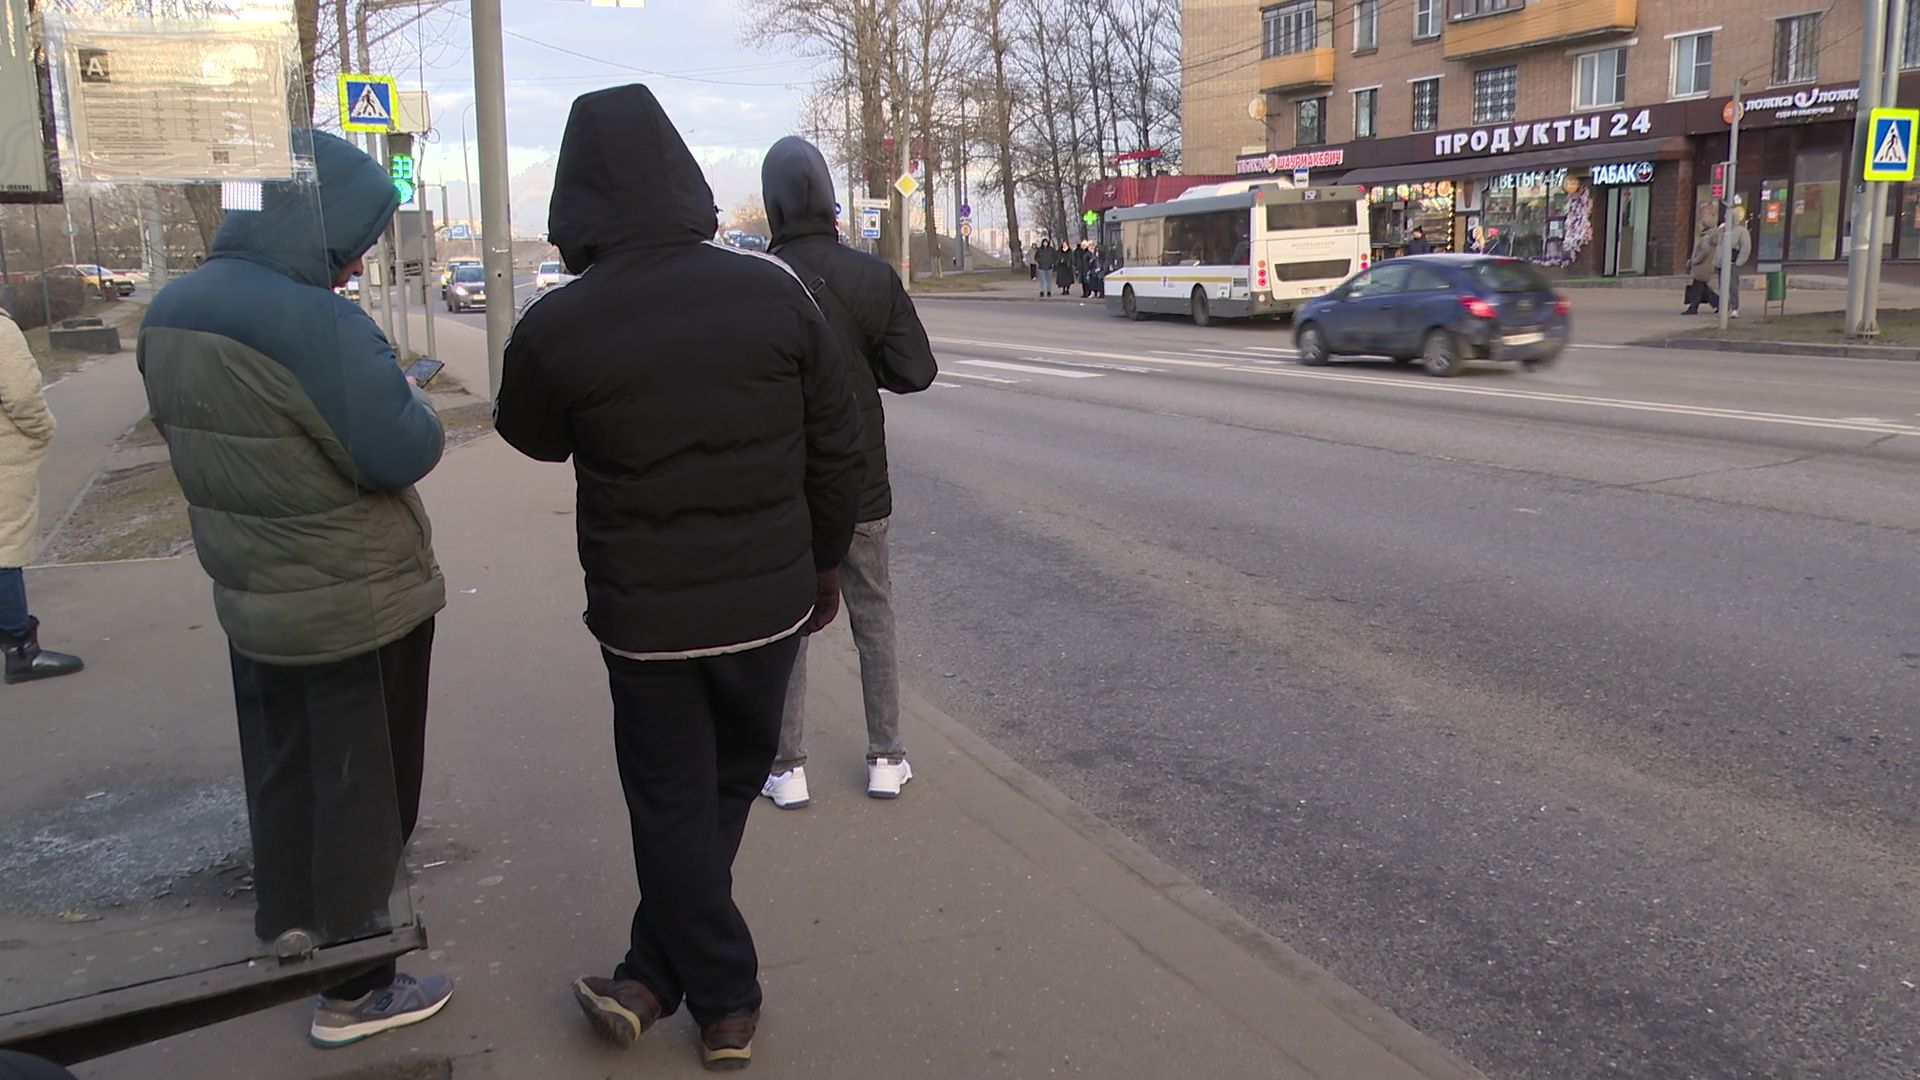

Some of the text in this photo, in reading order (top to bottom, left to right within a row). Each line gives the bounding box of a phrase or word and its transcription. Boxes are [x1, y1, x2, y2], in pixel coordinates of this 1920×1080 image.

[1817, 88, 1860, 103] ложк
[1435, 109, 1651, 155] ПРОДУКТЫ 24
[1278, 150, 1343, 169] ШАУРМАКЕВИЧ
[1592, 162, 1638, 186] ТАБАК
